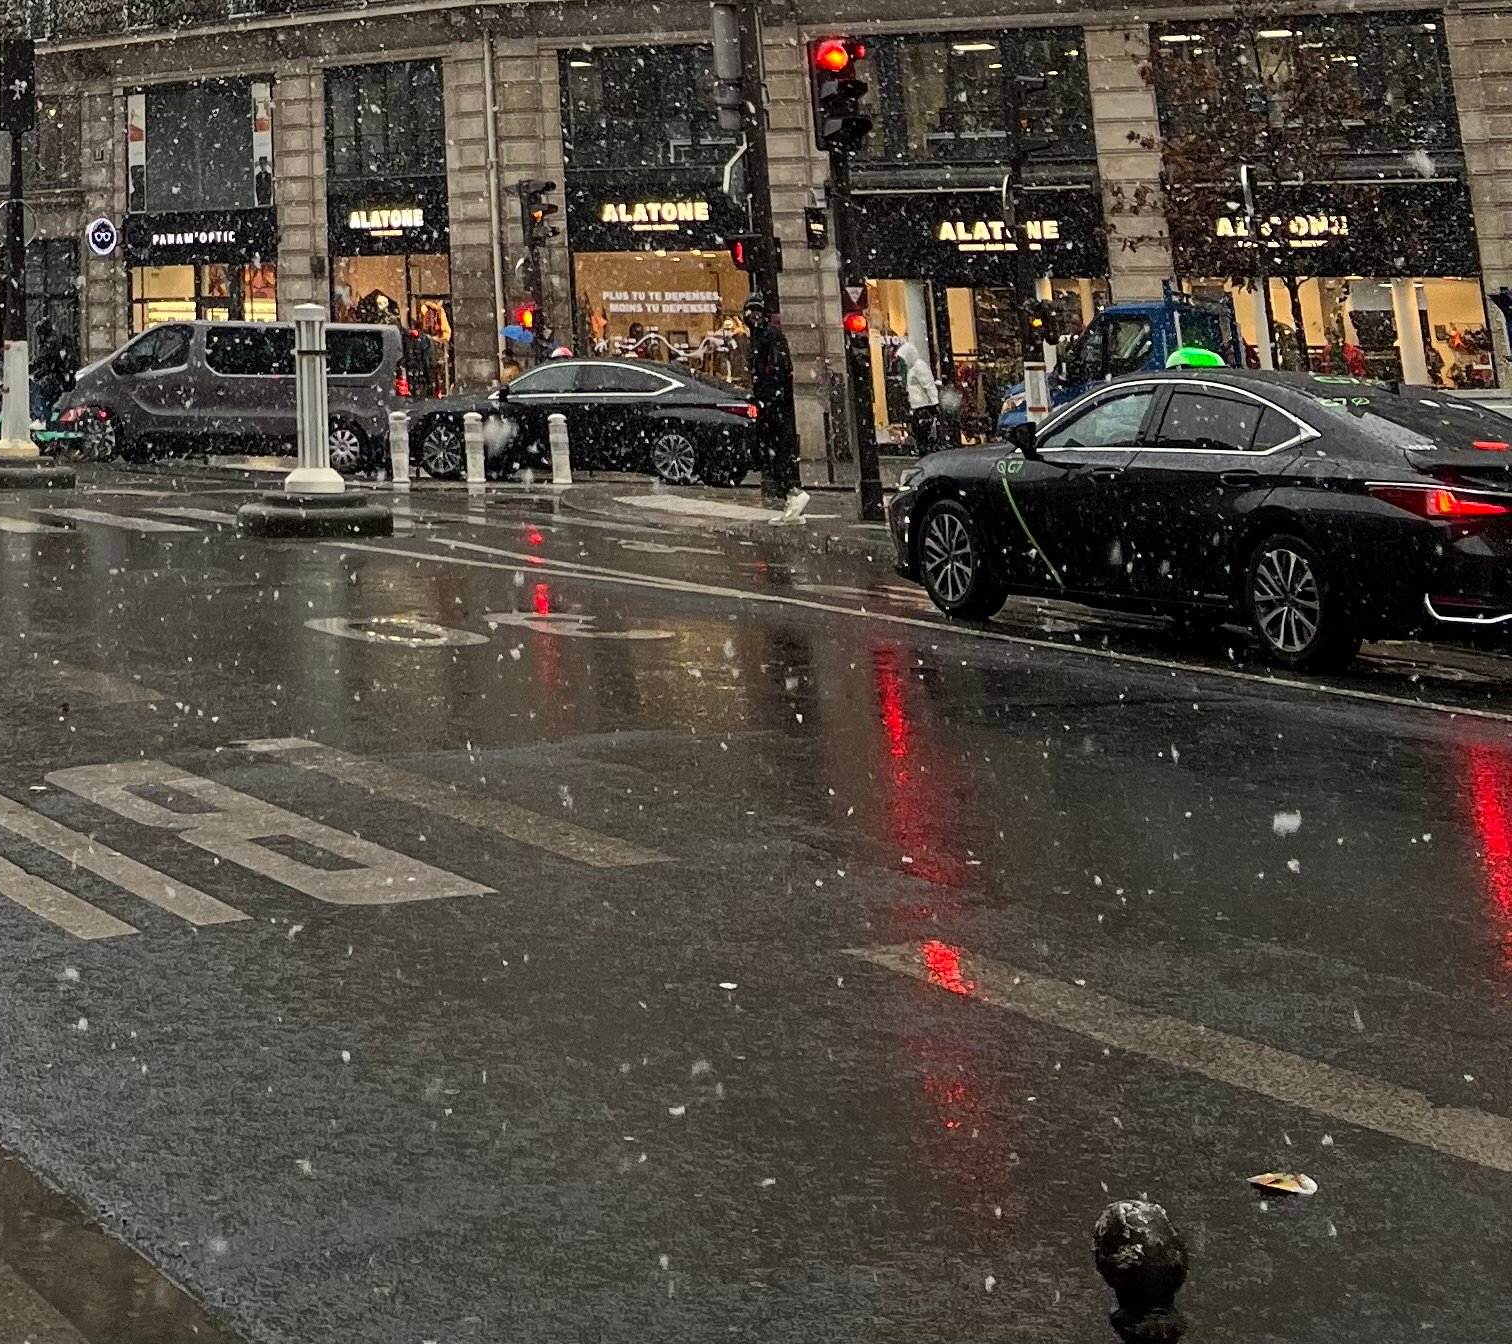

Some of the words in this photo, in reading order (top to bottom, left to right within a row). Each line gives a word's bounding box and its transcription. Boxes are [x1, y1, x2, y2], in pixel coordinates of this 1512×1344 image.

[349, 208, 424, 229] ALATONE
[602, 202, 709, 222] ALATONE
[152, 230, 236, 246] PANAM'OPTIC
[939, 220, 1059, 241] ALATNE
[602, 291, 630, 301] PLUS
[631, 291, 646, 301] TU
[649, 291, 663, 301] TE
[609, 302, 644, 313] MOINS
[645, 302, 660, 313] TU
